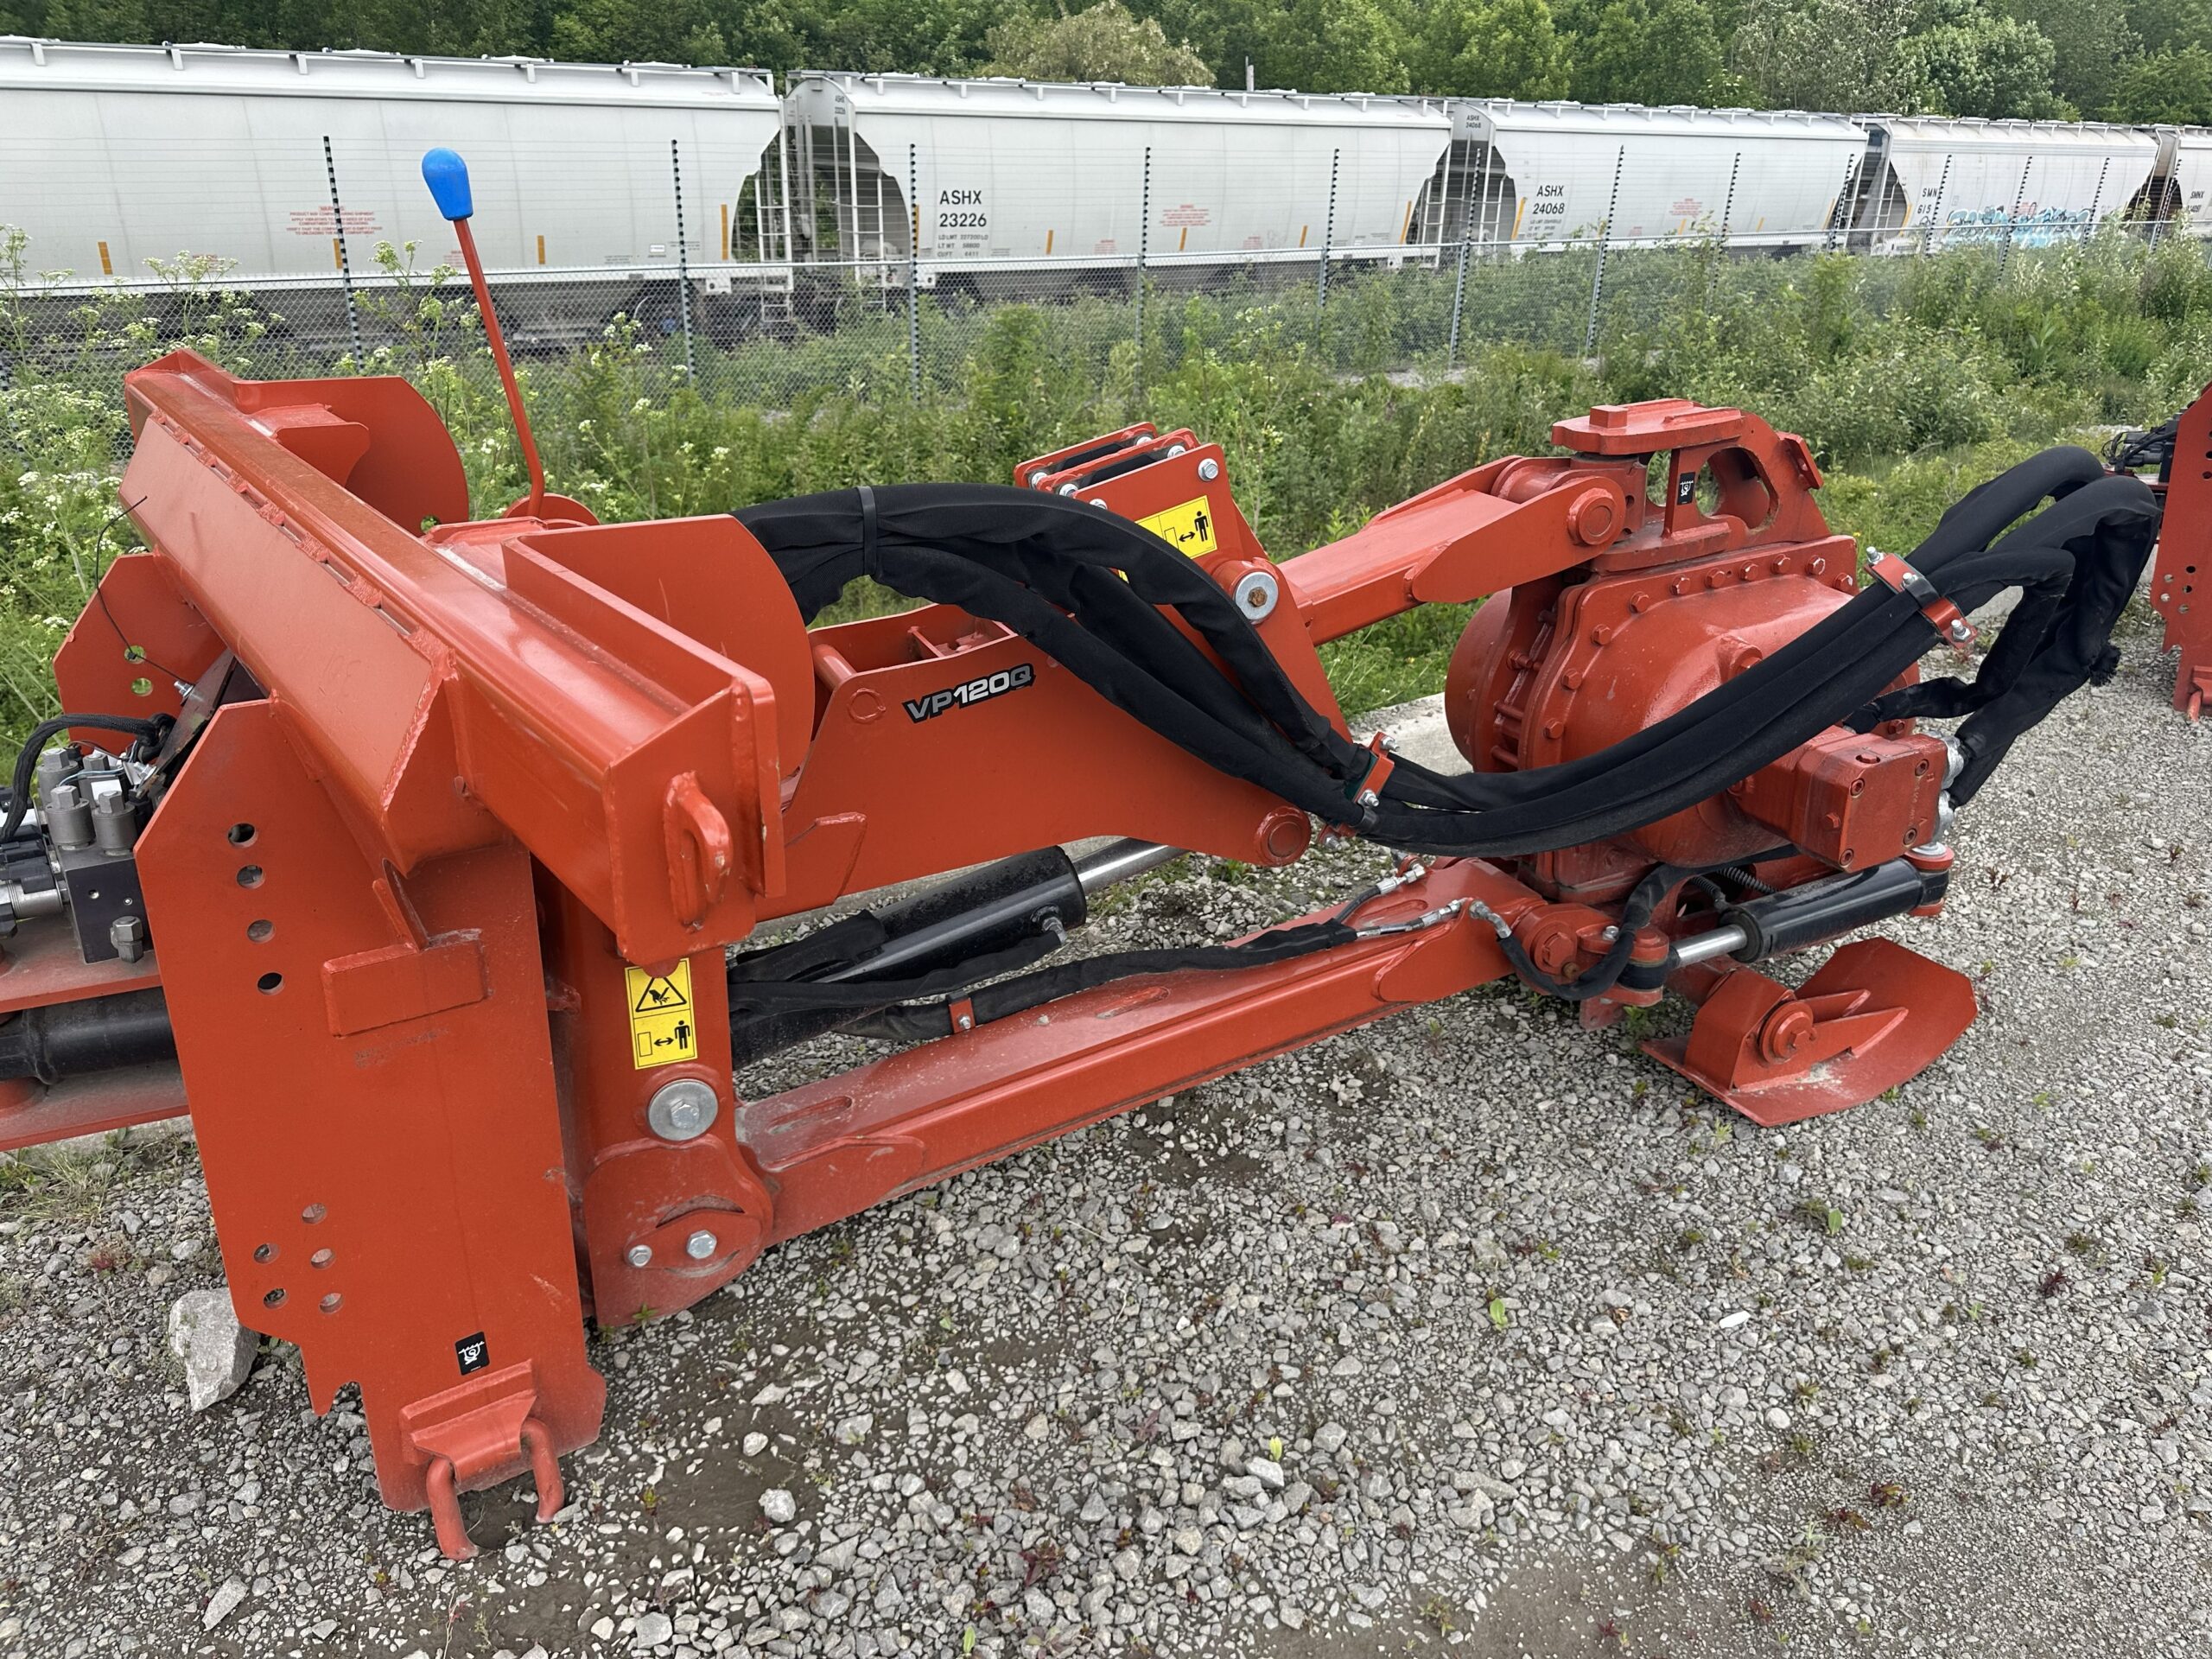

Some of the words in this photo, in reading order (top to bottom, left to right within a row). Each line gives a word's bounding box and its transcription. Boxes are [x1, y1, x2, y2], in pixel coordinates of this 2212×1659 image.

[939, 190, 982, 205] ASHX
[1536, 185, 1564, 197] ASHX
[1533, 202, 1565, 214] 24068
[939, 213, 987, 227] 23226
[905, 664, 1033, 721] VP120Q
